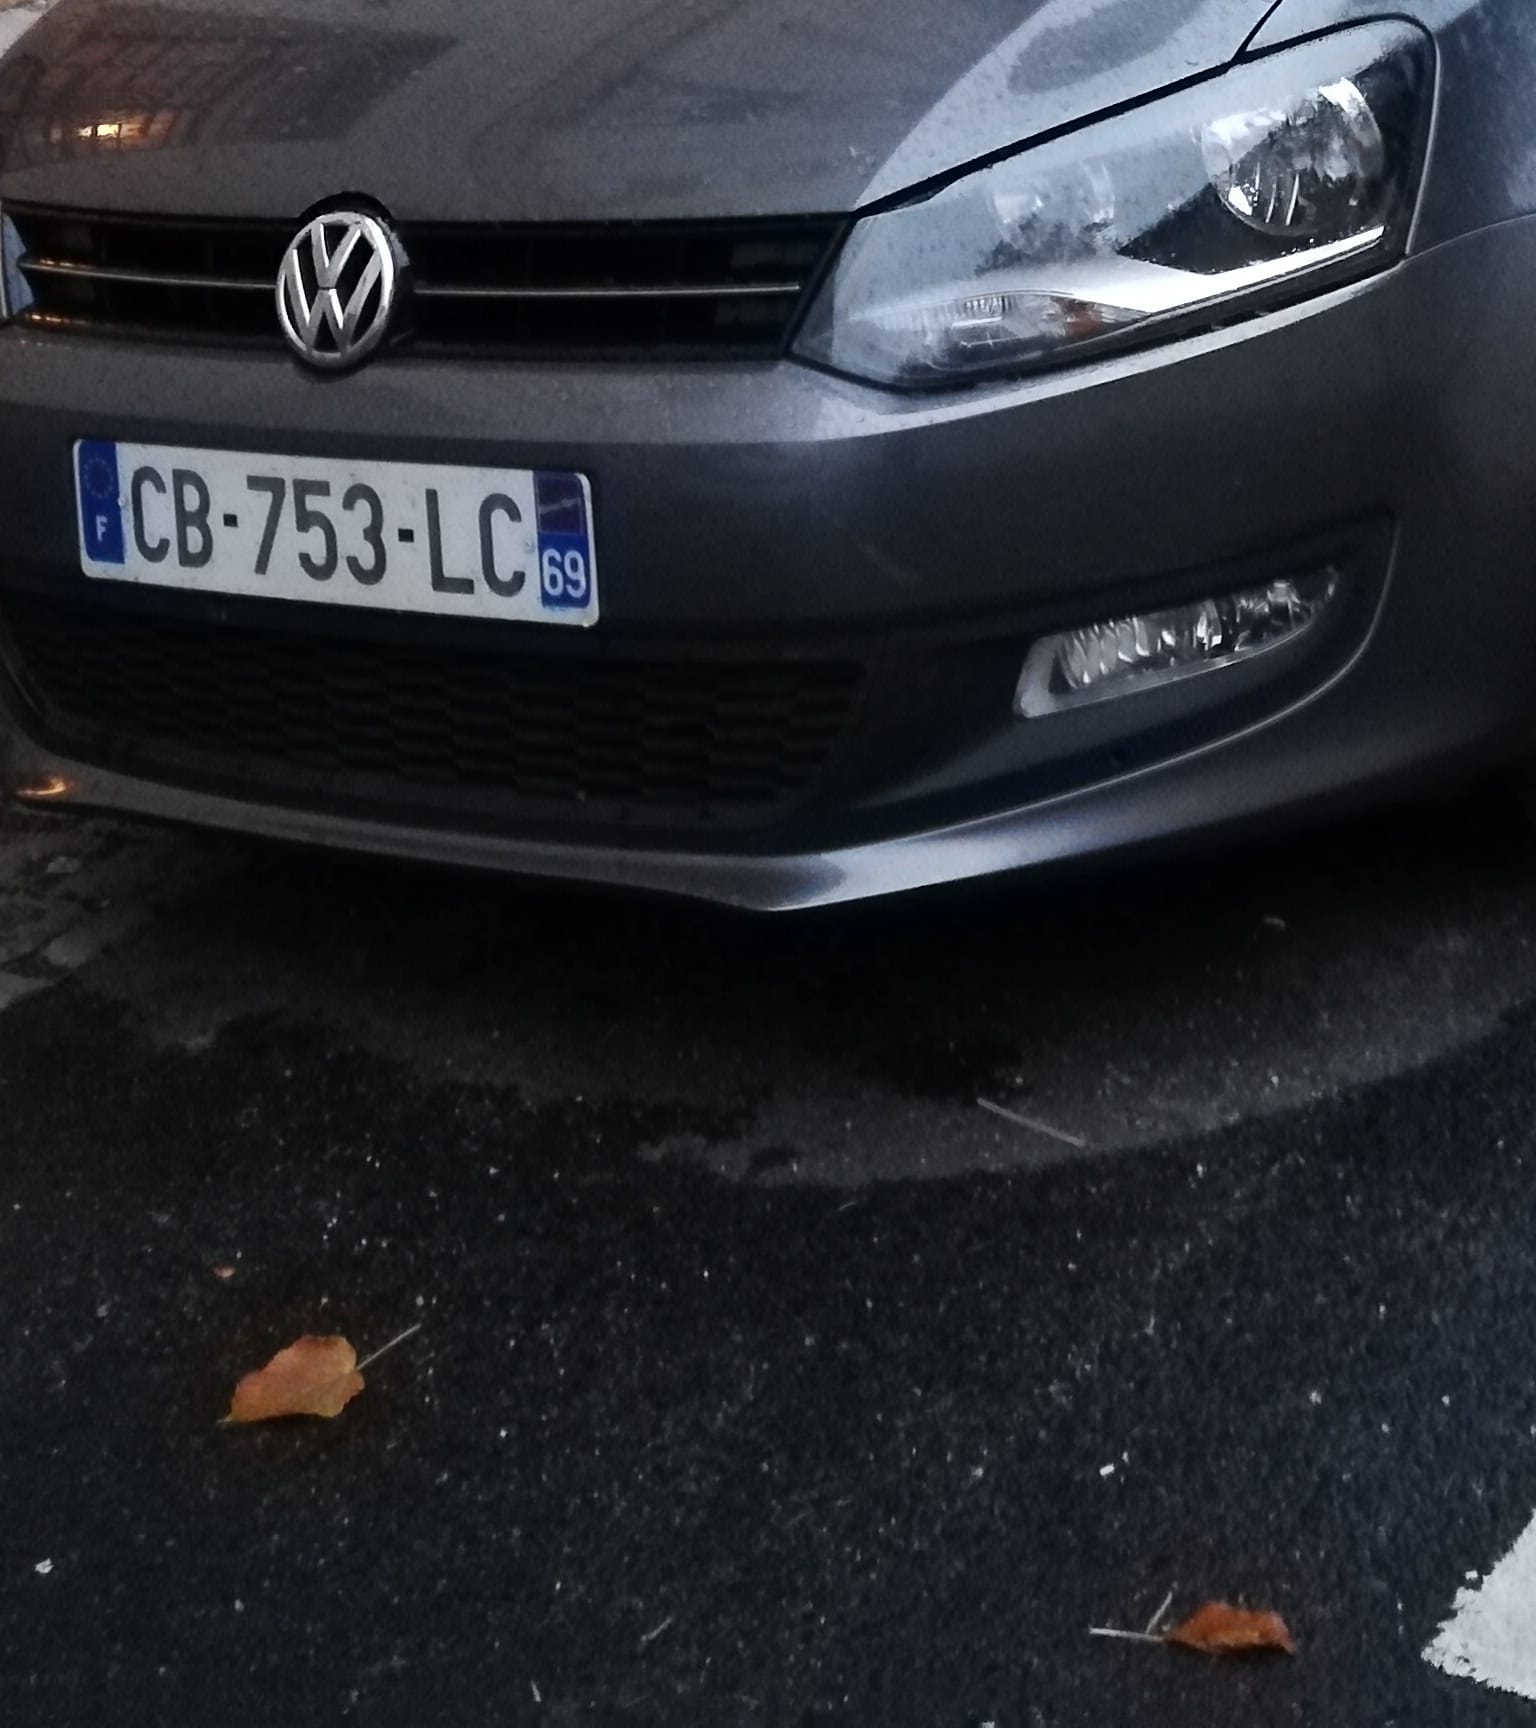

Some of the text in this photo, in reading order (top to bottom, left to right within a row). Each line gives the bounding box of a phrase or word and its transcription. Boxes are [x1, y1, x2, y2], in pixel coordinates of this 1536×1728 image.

[95, 515, 107, 542] F
[131, 465, 527, 598] CB-753-LC
[542, 548, 587, 599] 69
